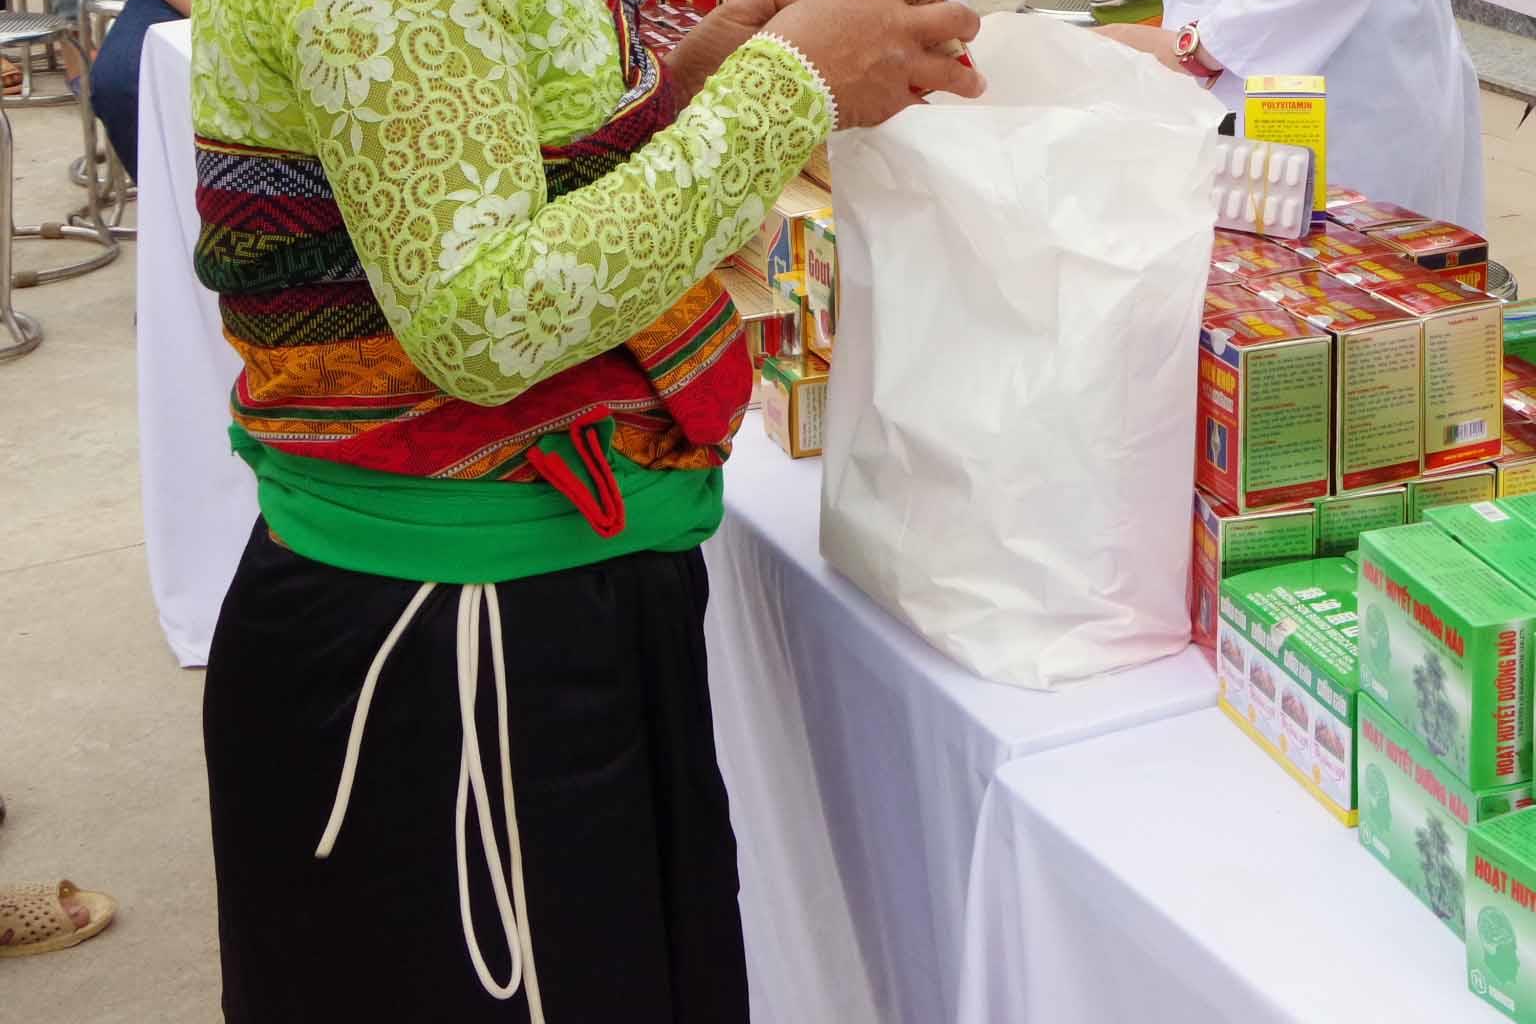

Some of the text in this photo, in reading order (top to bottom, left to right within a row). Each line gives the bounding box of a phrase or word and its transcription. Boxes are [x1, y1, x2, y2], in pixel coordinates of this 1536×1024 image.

[1492, 630, 1519, 776] HOẠT HUYẾT DƯỠNG NÃO
[1475, 855, 1508, 895] HOẠT
